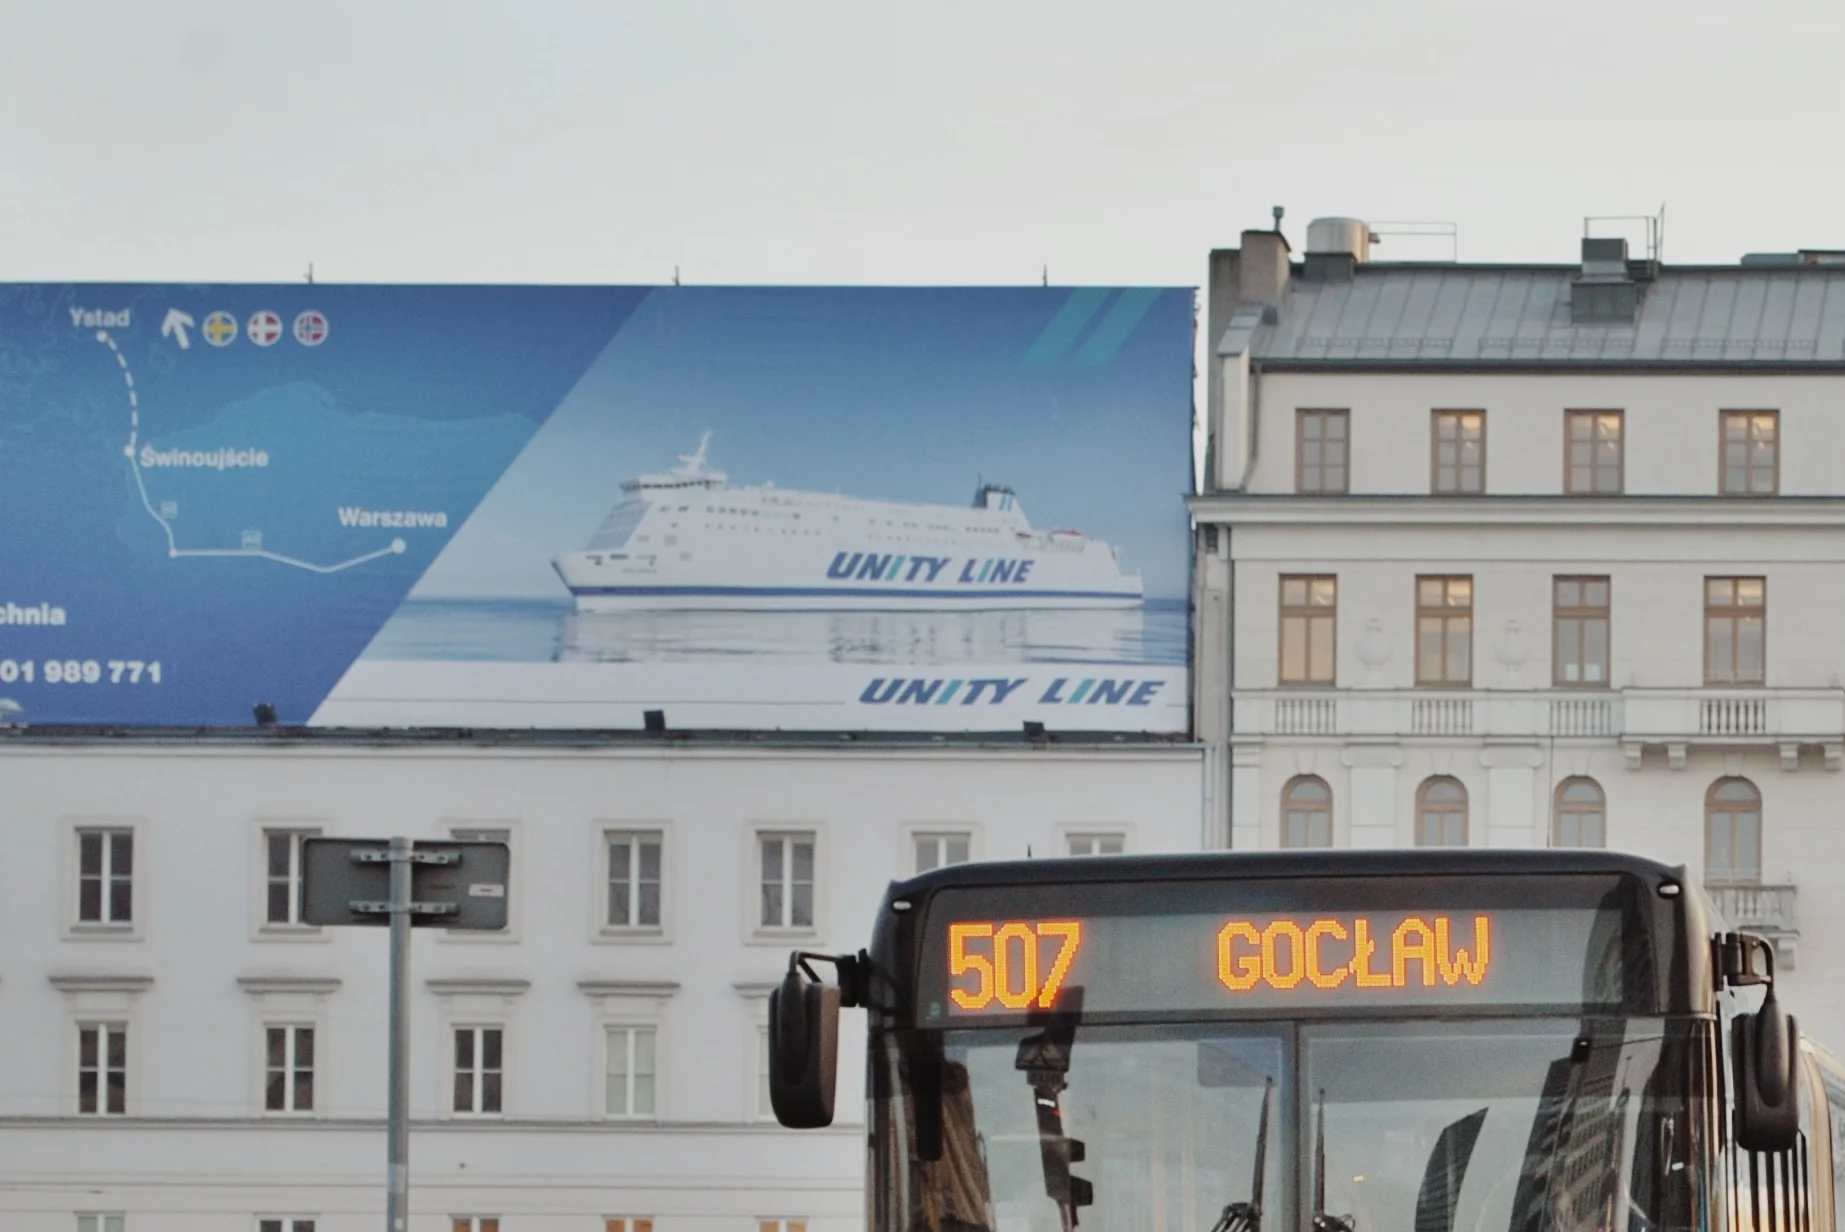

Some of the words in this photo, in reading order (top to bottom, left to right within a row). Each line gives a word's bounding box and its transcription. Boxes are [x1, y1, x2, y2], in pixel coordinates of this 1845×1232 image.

[69, 307, 131, 328] Ystad
[139, 443, 269, 470] Świnoujście
[338, 506, 448, 528] Warszawa
[826, 551, 951, 582] UNITY
[957, 557, 1035, 584] LINE
[44, 659, 101, 684] 989
[107, 660, 161, 684] 771
[858, 678, 1029, 705] UNITY
[1037, 678, 1166, 706] LINE
[949, 921, 1080, 1009] 507
[1218, 916, 1489, 990] GOCŁAW
